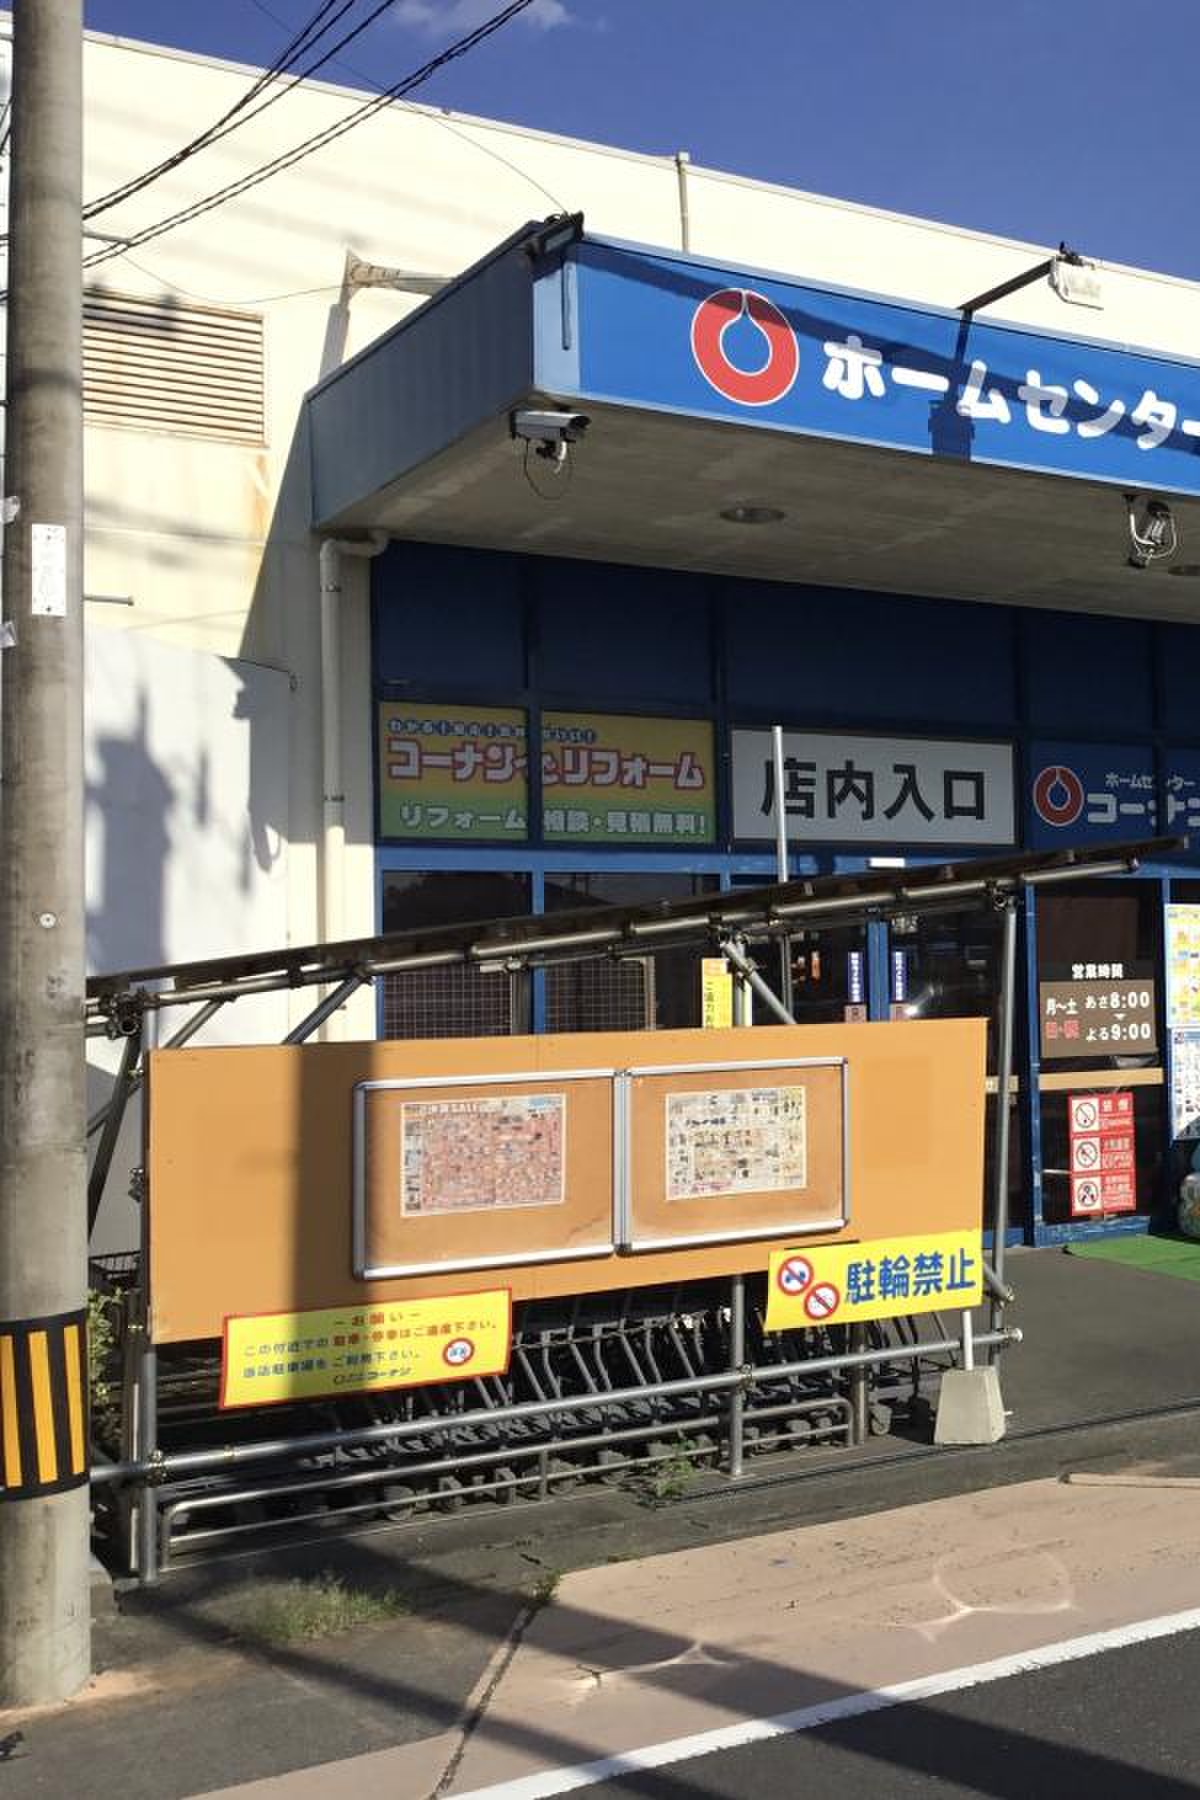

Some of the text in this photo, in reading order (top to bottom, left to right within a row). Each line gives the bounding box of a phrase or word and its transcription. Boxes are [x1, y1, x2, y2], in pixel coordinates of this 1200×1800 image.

[762, 757, 986, 822] 店内入口
[1105, 772, 1196, 792] ホームセター
[1071, 963, 1124, 979] 営業時間
[845, 1248, 976, 1305] 駐輪禁止
